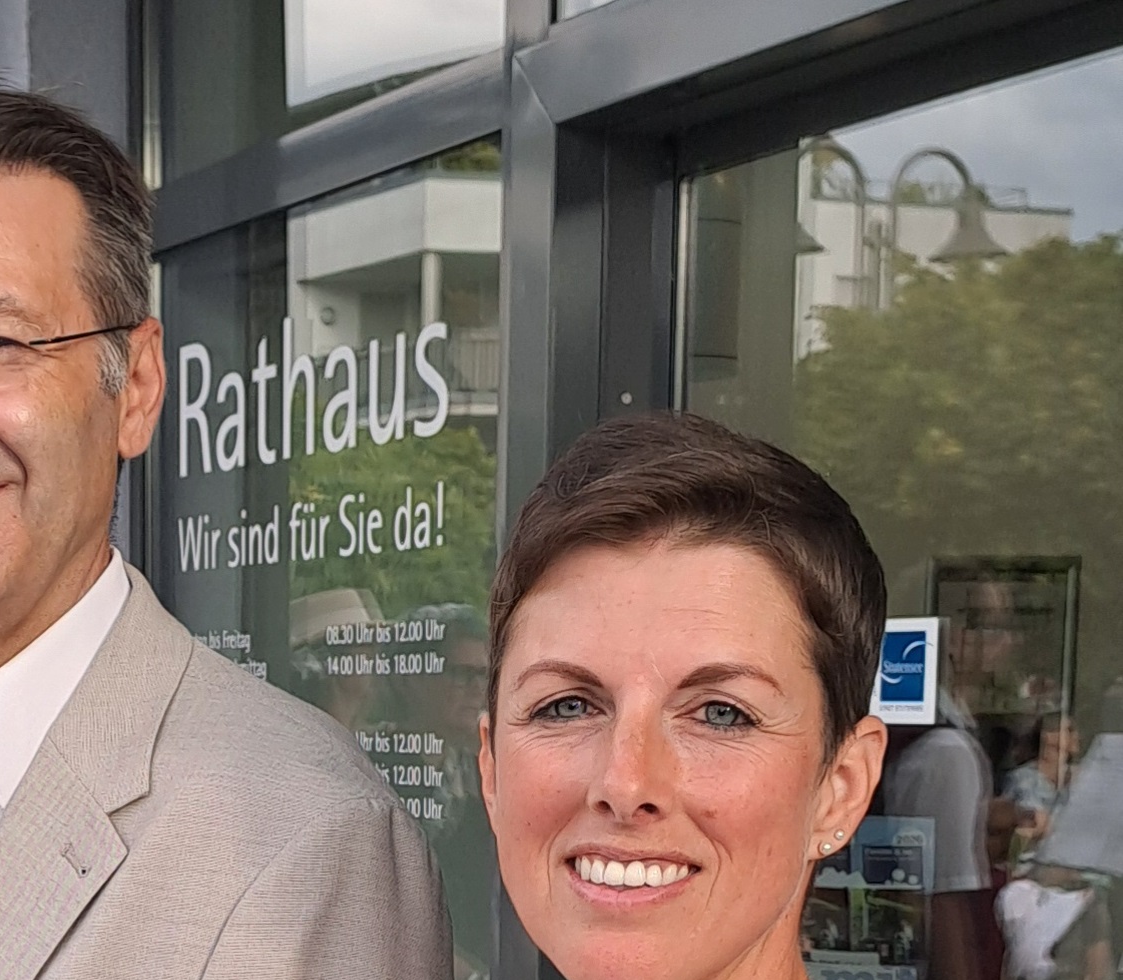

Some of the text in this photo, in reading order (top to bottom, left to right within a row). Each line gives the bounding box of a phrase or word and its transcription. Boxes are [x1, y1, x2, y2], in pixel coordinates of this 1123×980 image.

[179, 317, 450, 478] Rathaus
[178, 481, 444, 573] Wir sind für Sie da!
[222, 629, 251, 653] Freitag
[325, 619, 446, 645] 08.30 Uhr bis 12.00 Uhr
[327, 651, 446, 676] 1400 Uhr bis 18.00 Uhr
[375, 731, 391, 752] bis
[393, 733, 422, 754] 12.00
[423, 732, 445, 755] Uhr
[393, 765, 422, 786] 12.00
[423, 765, 445, 787] Uhr
[423, 797, 444, 819] Uhr
